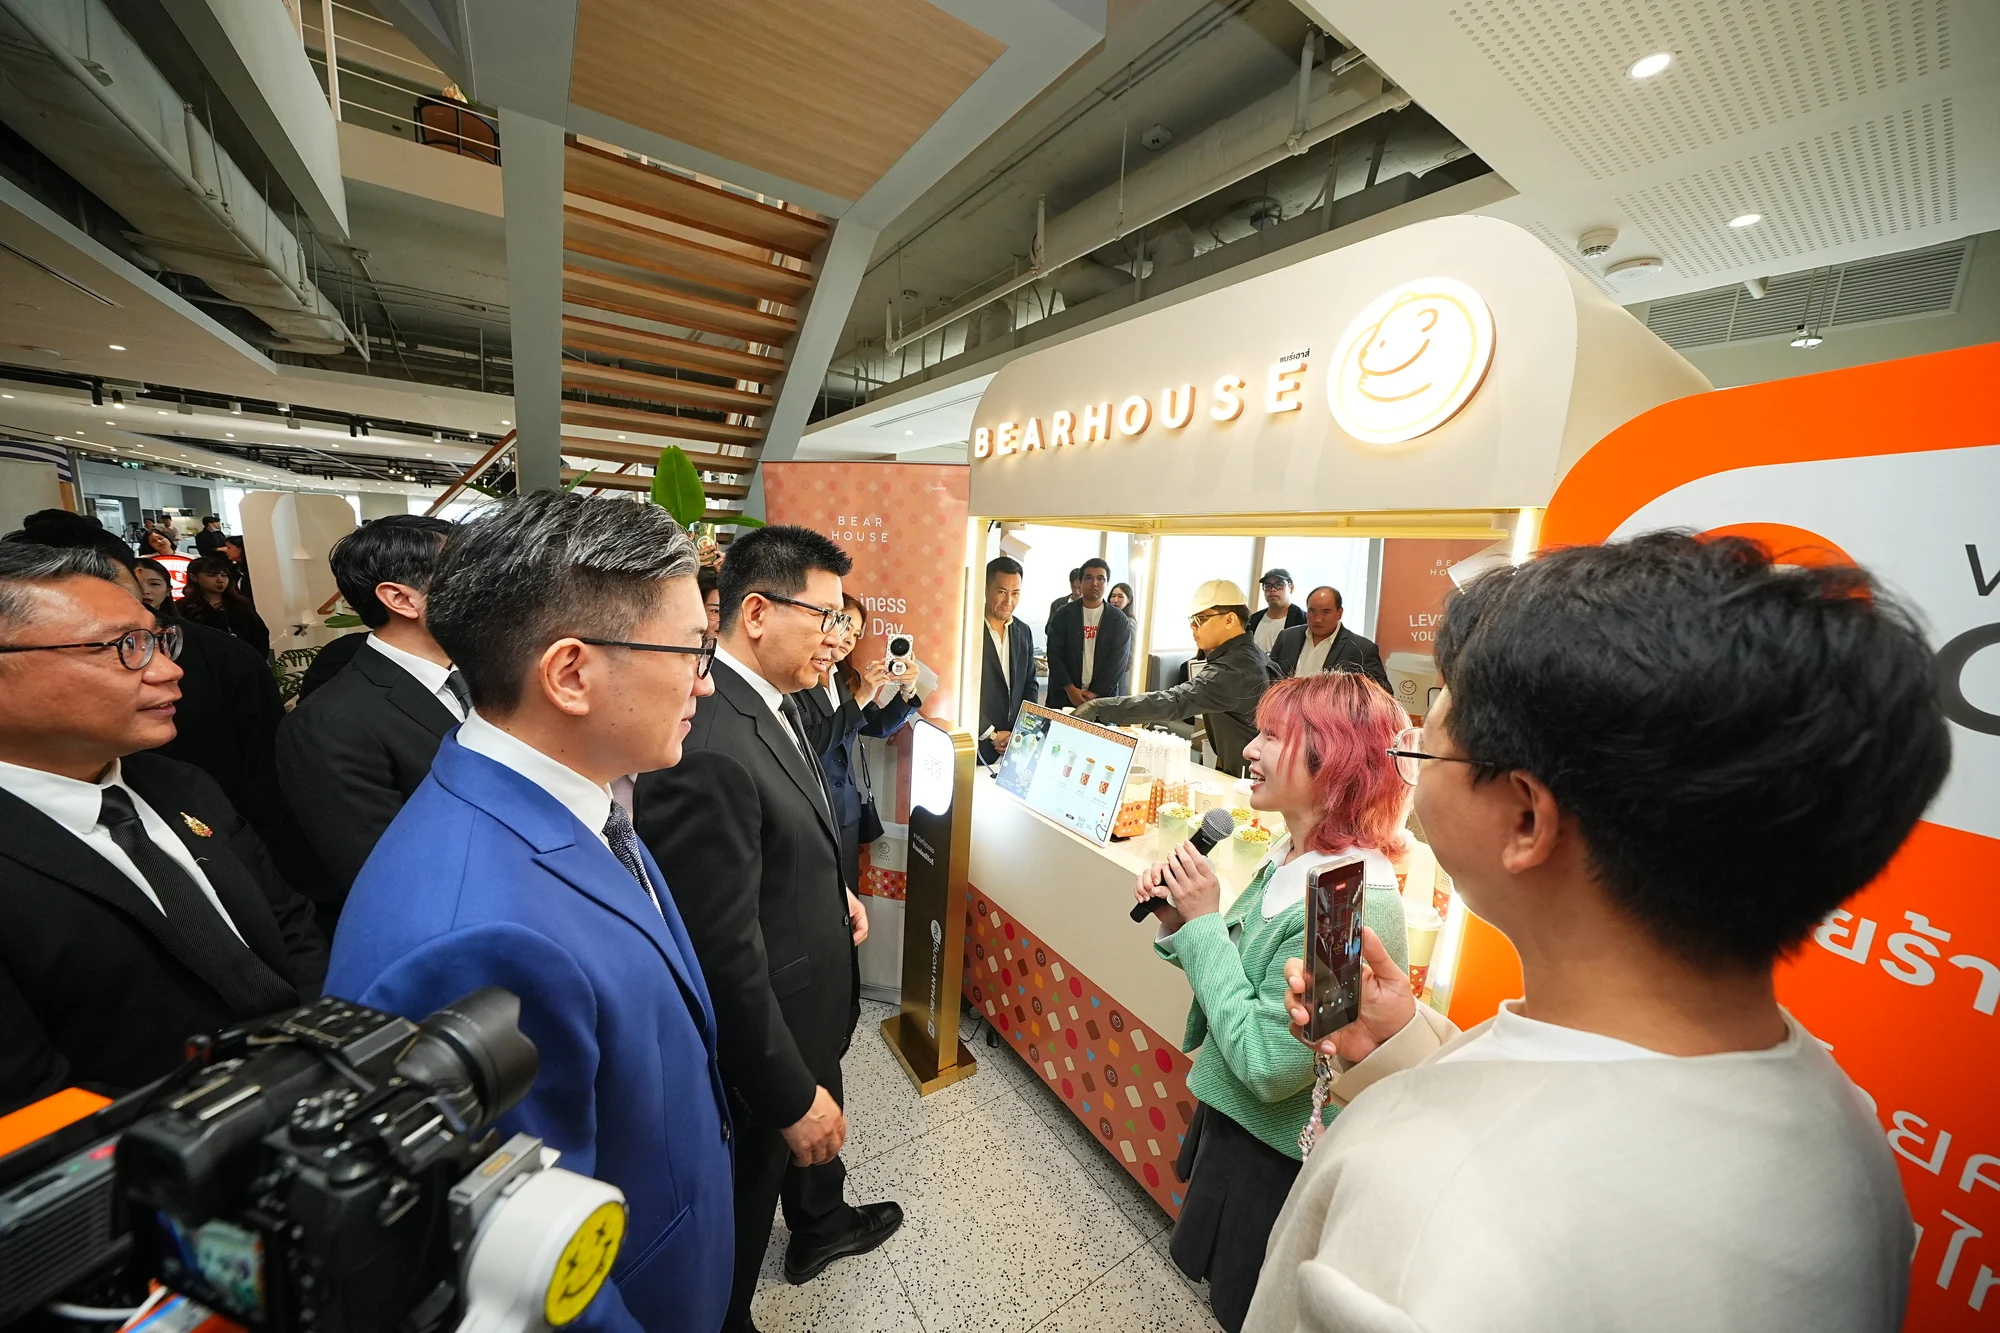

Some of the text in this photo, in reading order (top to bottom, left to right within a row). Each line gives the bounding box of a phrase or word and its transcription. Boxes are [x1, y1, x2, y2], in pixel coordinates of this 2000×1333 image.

[974, 361, 1307, 459] BEARHOUSE
[838, 515, 883, 527] BEAR
[831, 530, 888, 543] HOUSE
[860, 592, 907, 614] iness
